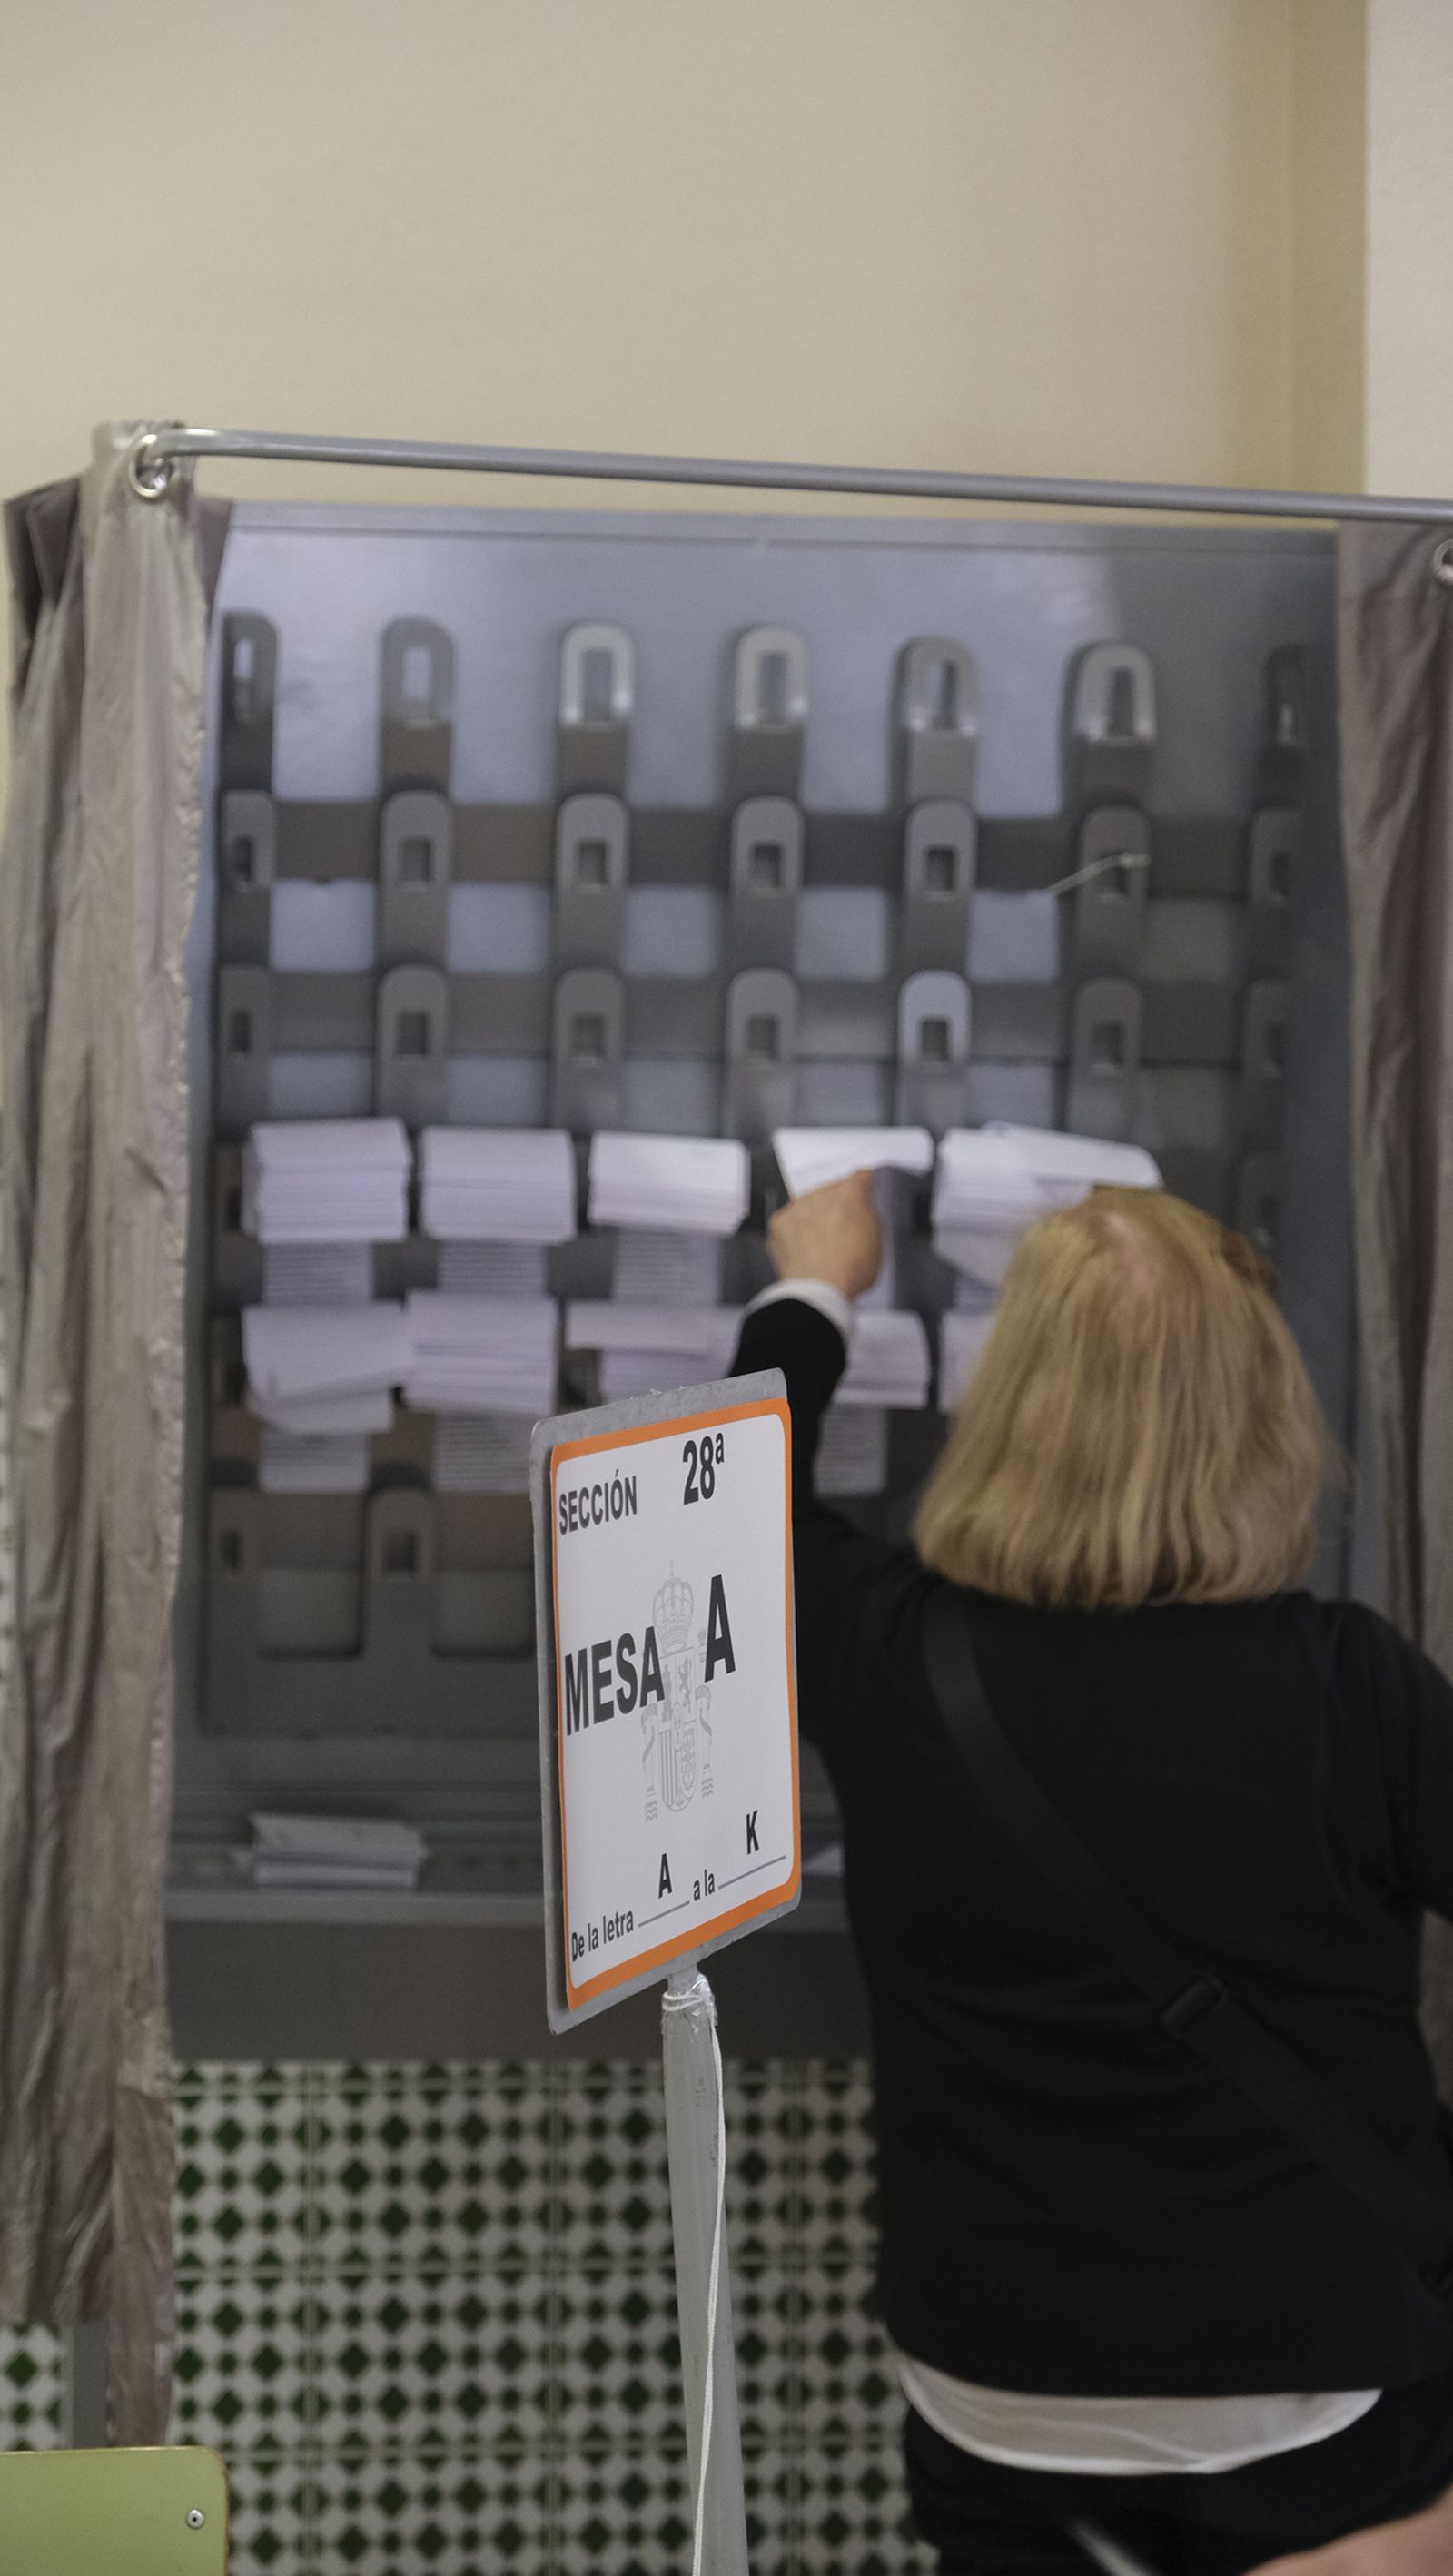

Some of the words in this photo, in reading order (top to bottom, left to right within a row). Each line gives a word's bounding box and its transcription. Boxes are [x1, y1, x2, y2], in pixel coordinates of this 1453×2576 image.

[558, 1469, 638, 1535] SECCIÓN
[564, 1626, 665, 1736] MESA
[705, 1574, 736, 1683] A
[571, 1931, 585, 1962] De
[588, 1923, 599, 1952] la
[603, 1910, 634, 1945] letra
[657, 1852, 672, 1899] A
[693, 1880, 700, 1902] a
[704, 1869, 715, 1897] la
[746, 1810, 759, 1855] K
